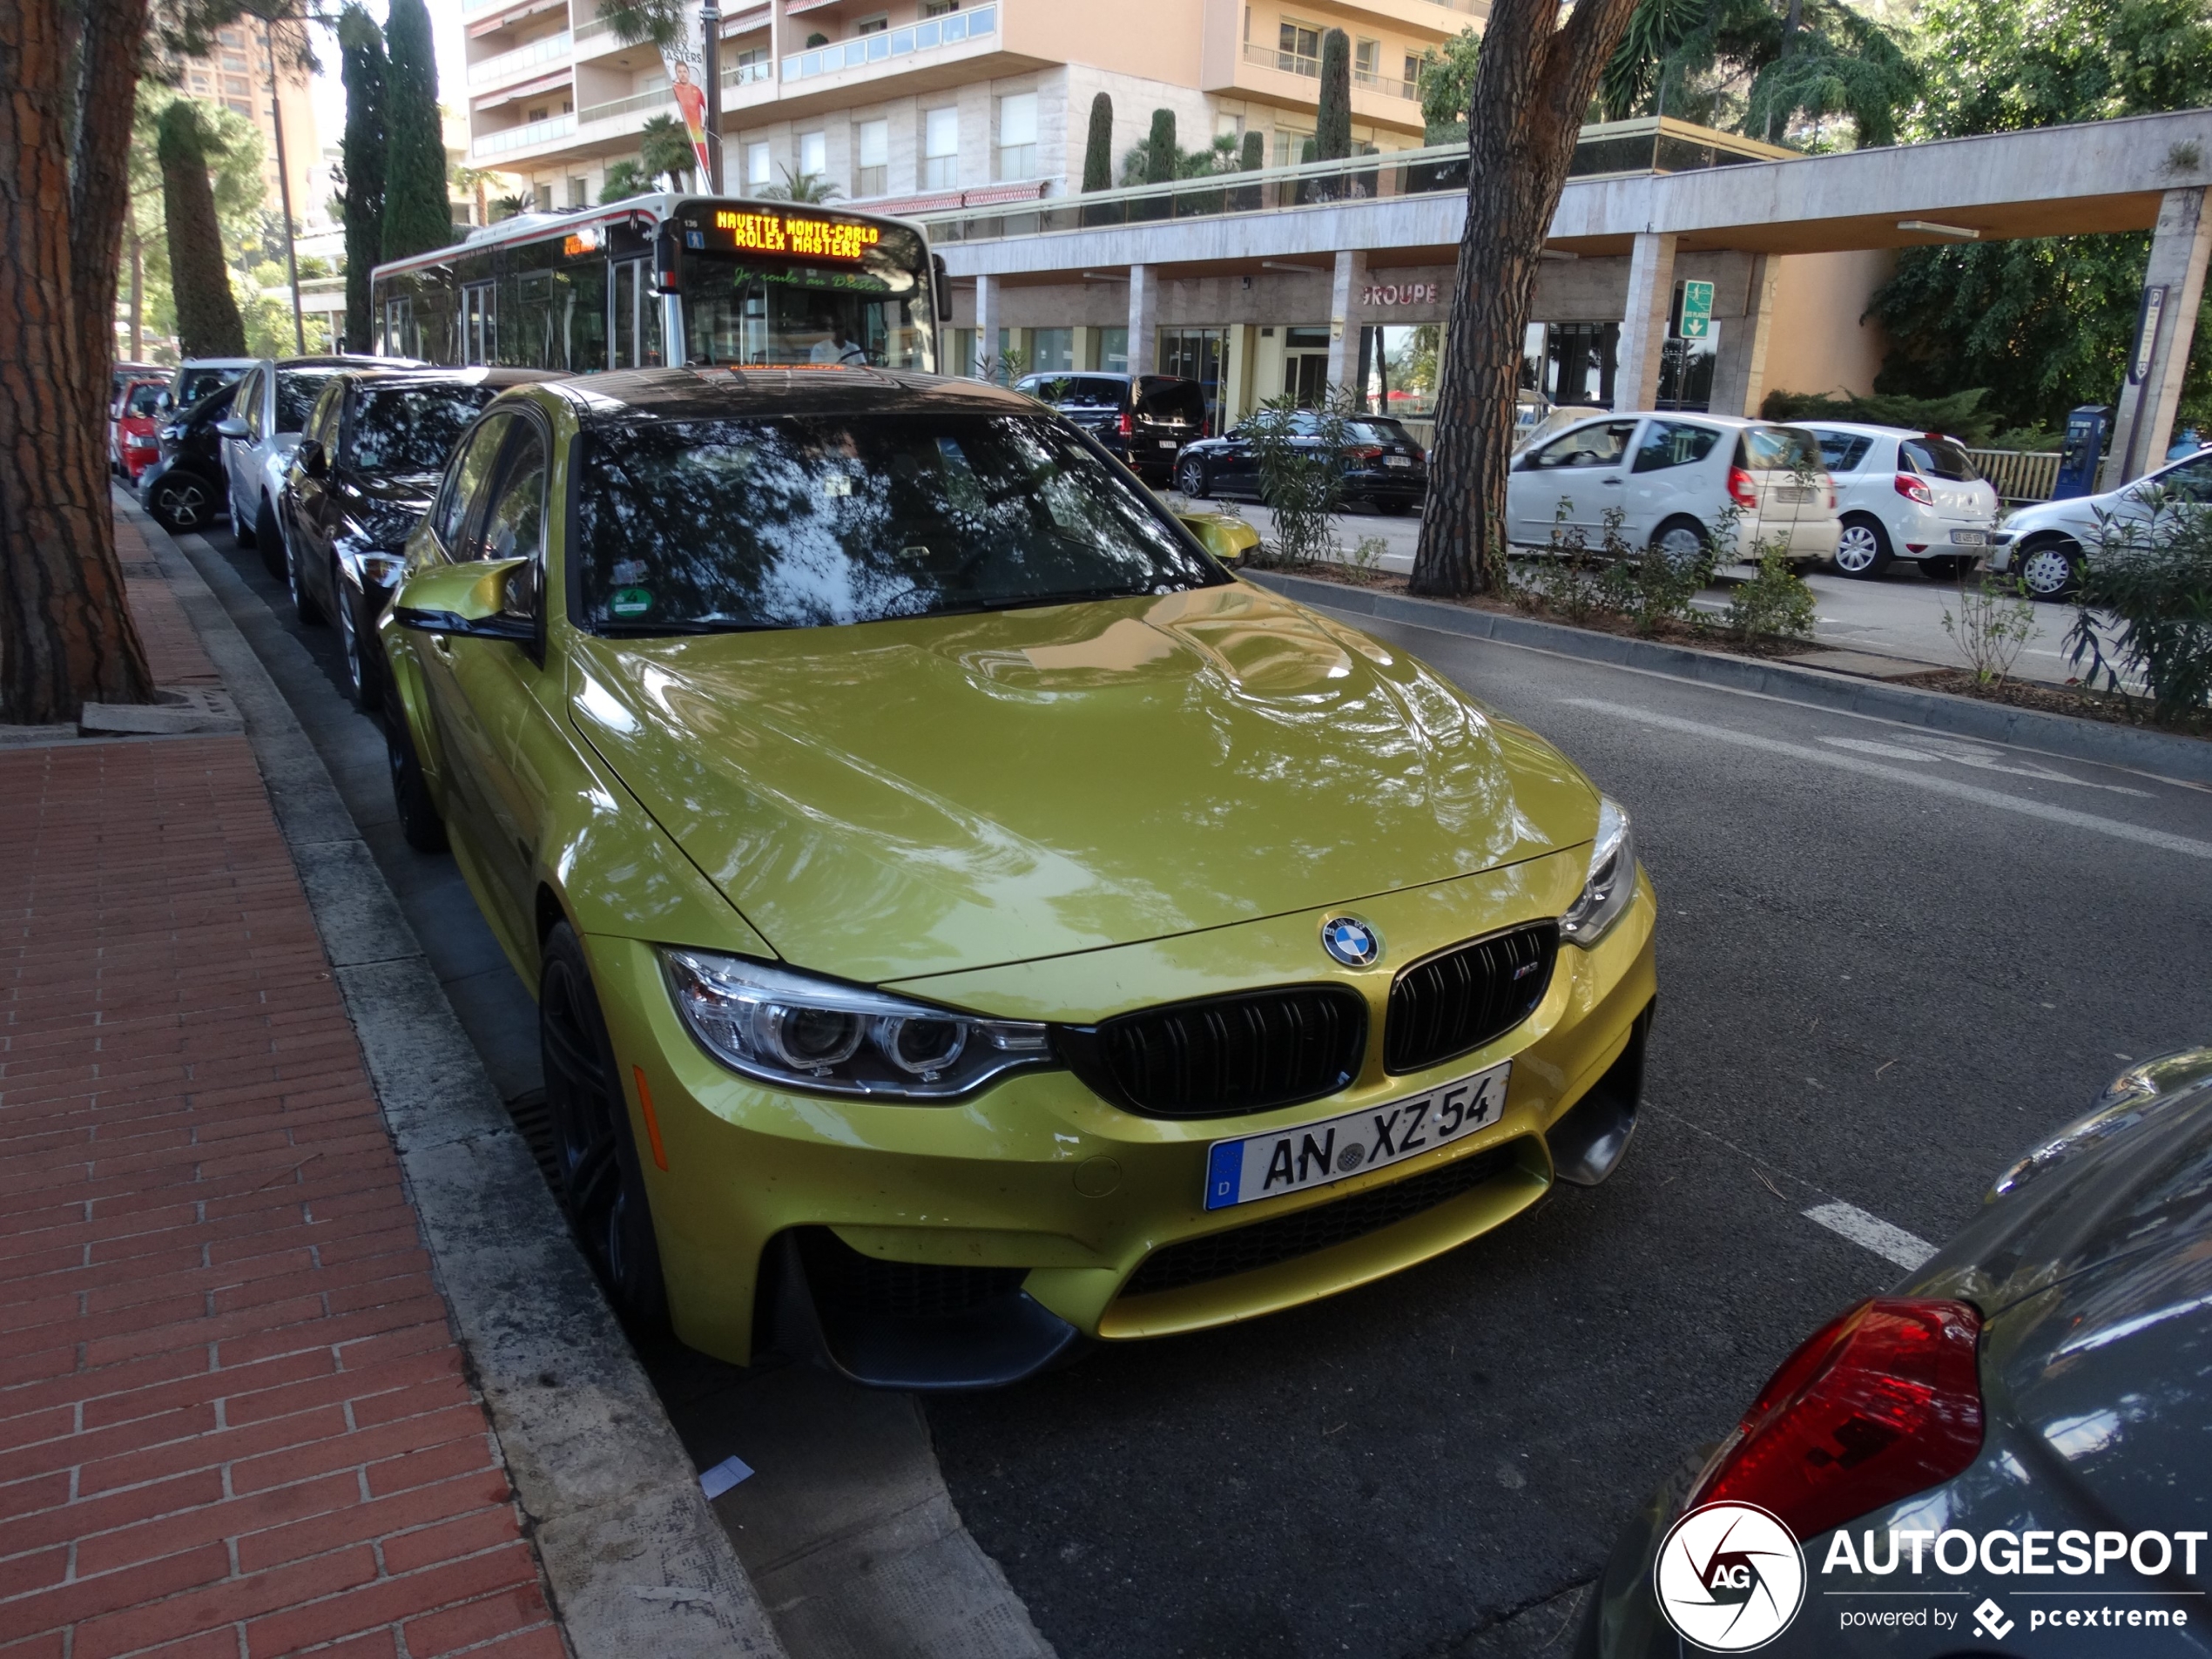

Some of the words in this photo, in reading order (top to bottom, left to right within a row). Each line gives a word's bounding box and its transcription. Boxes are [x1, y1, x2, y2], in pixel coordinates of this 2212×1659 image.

[717, 212, 779, 233] NAVETTE
[786, 219, 879, 244] MONTE-CARLO
[735, 229, 785, 251] ROLEX
[792, 235, 860, 258] MASTERS
[734, 267, 752, 287] Je
[806, 276, 826, 287] au
[2152, 293, 2160, 306] P
[2098, 419, 2106, 434] P
[626, 590, 638, 603] 4
[1219, 1182, 1230, 1195] D
[1264, 1129, 1336, 1190] AN
[1367, 1099, 1431, 1164] XZ
[1439, 1076, 1492, 1137] 54
